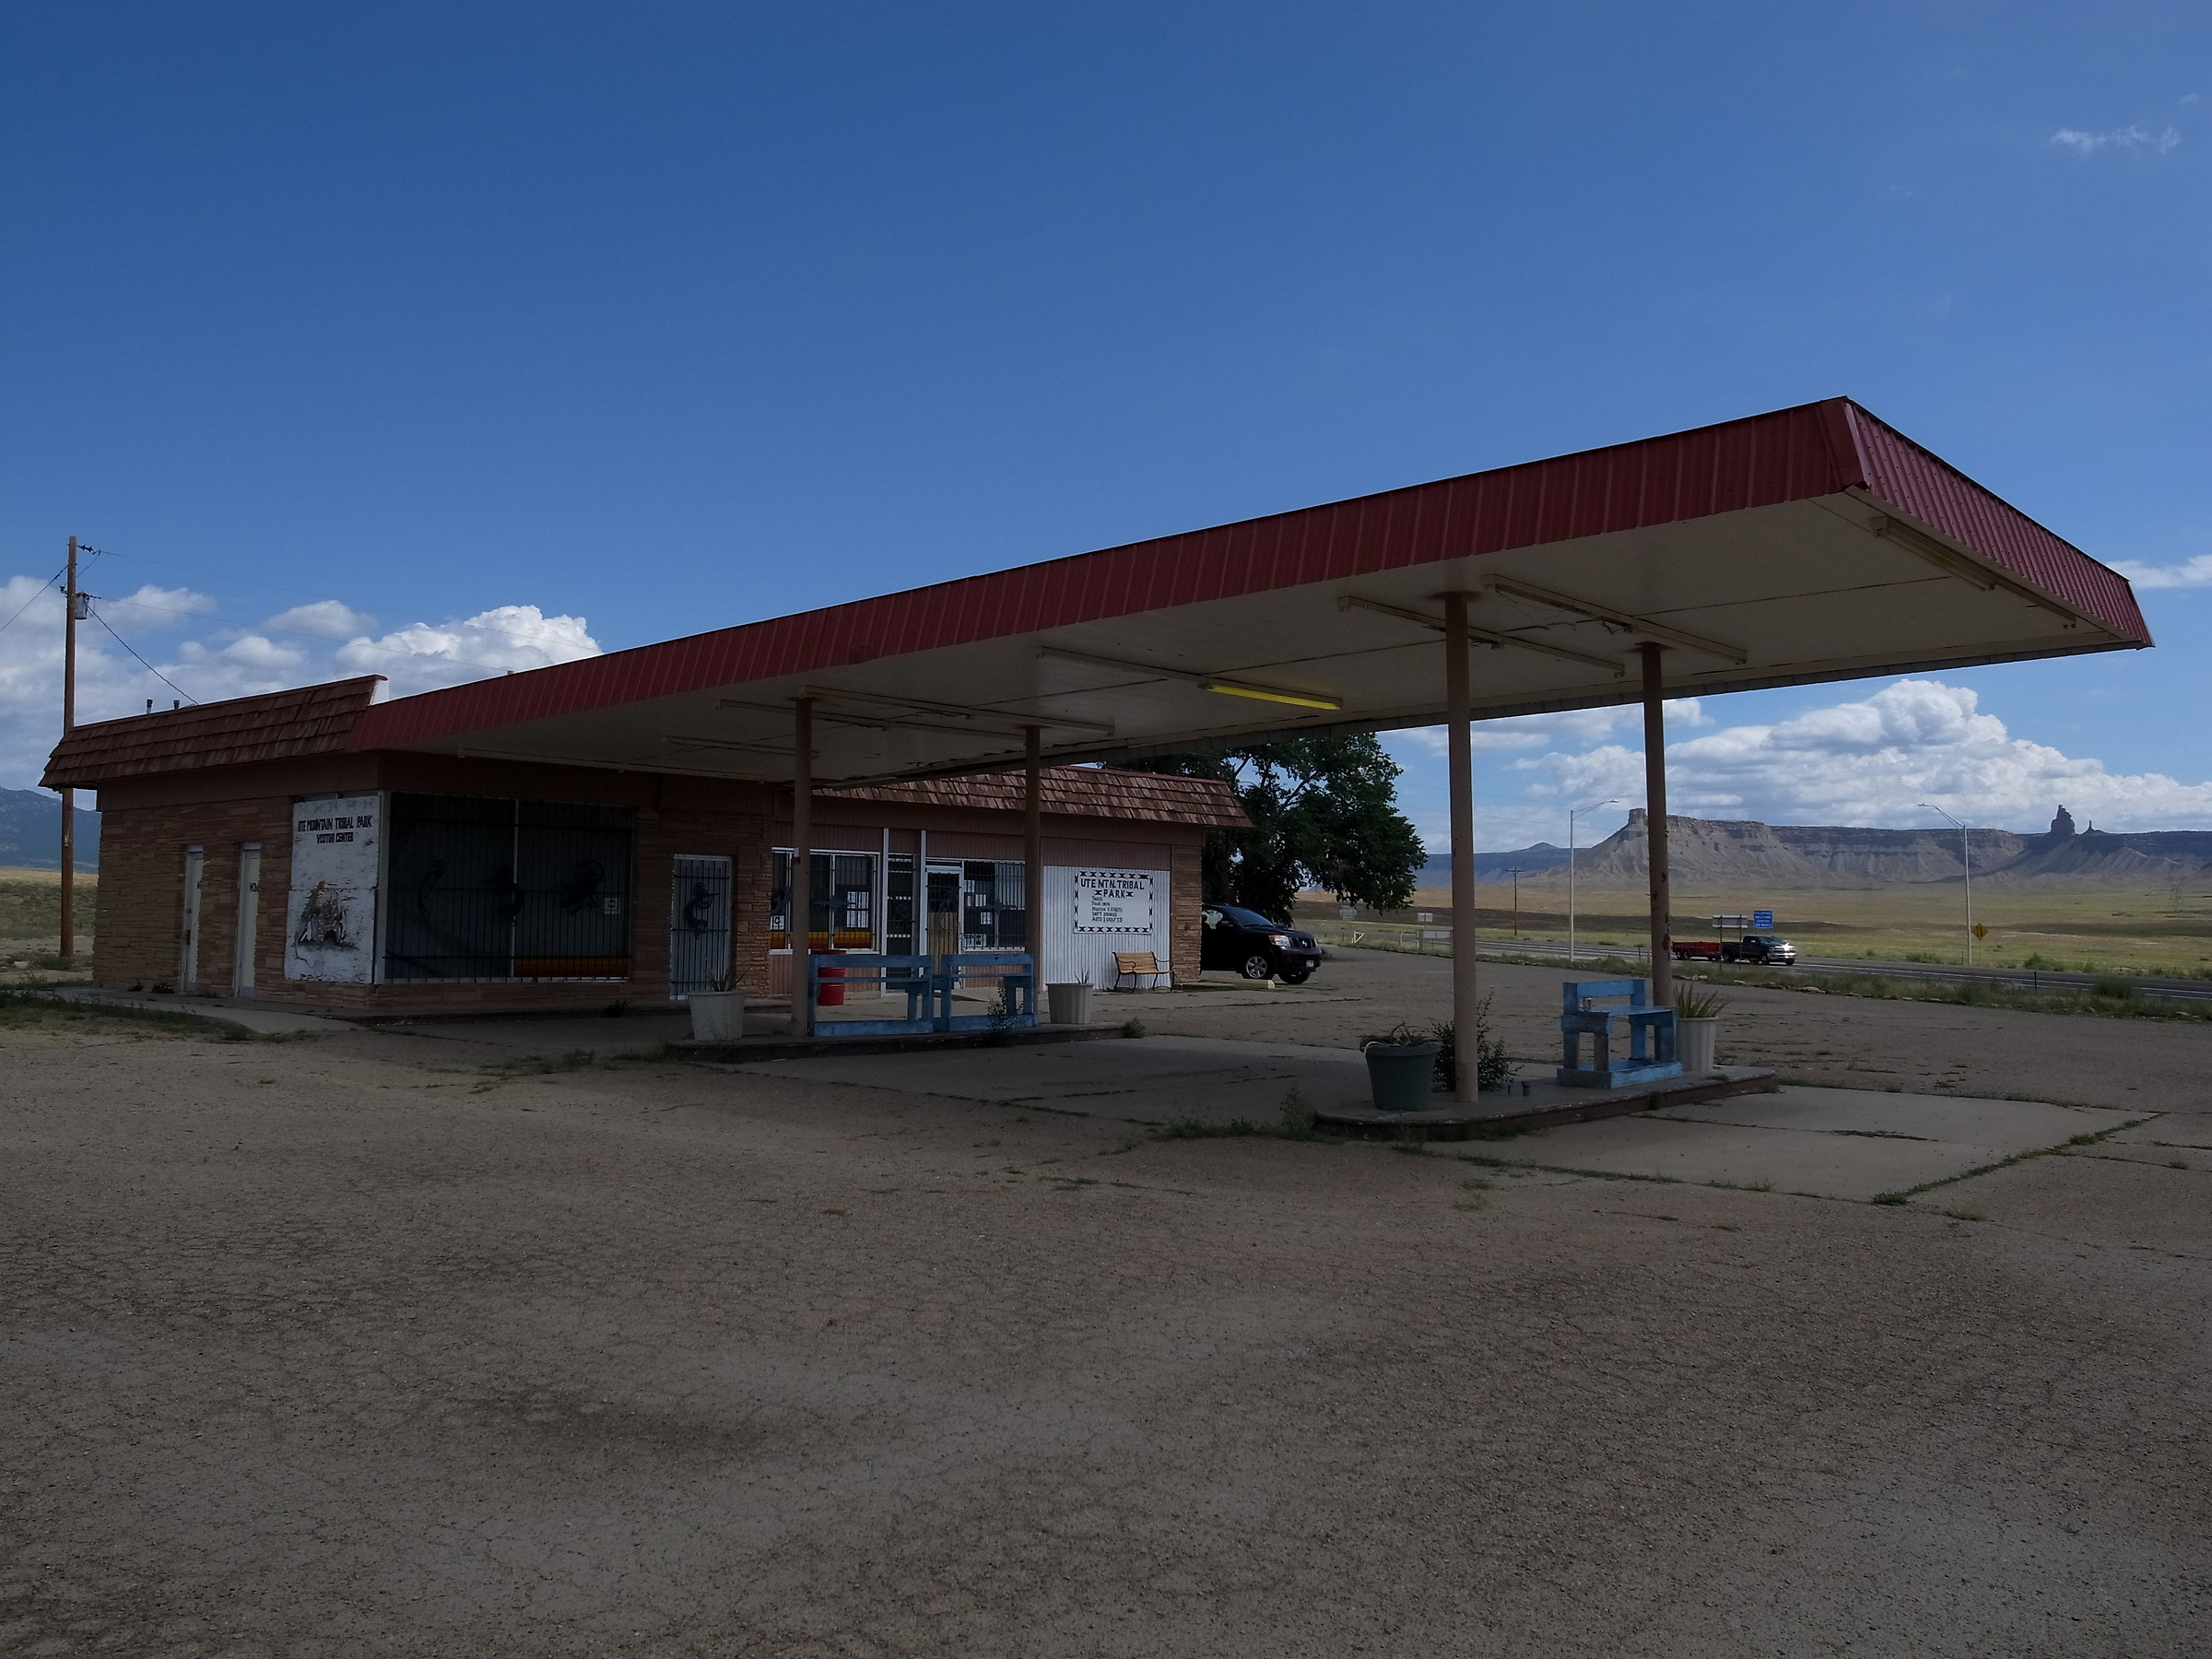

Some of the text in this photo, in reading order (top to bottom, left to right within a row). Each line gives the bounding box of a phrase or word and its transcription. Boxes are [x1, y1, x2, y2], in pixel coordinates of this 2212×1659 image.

[307, 818, 334, 831] MOUNTAIN
[335, 817, 354, 830] TRIBAL
[357, 815, 372, 829] PARK
[335, 832, 354, 843] CENTER
[1080, 878, 1096, 888] UTE
[1117, 880, 1145, 890] TRIBAL
[1103, 889, 1125, 899] PARK
